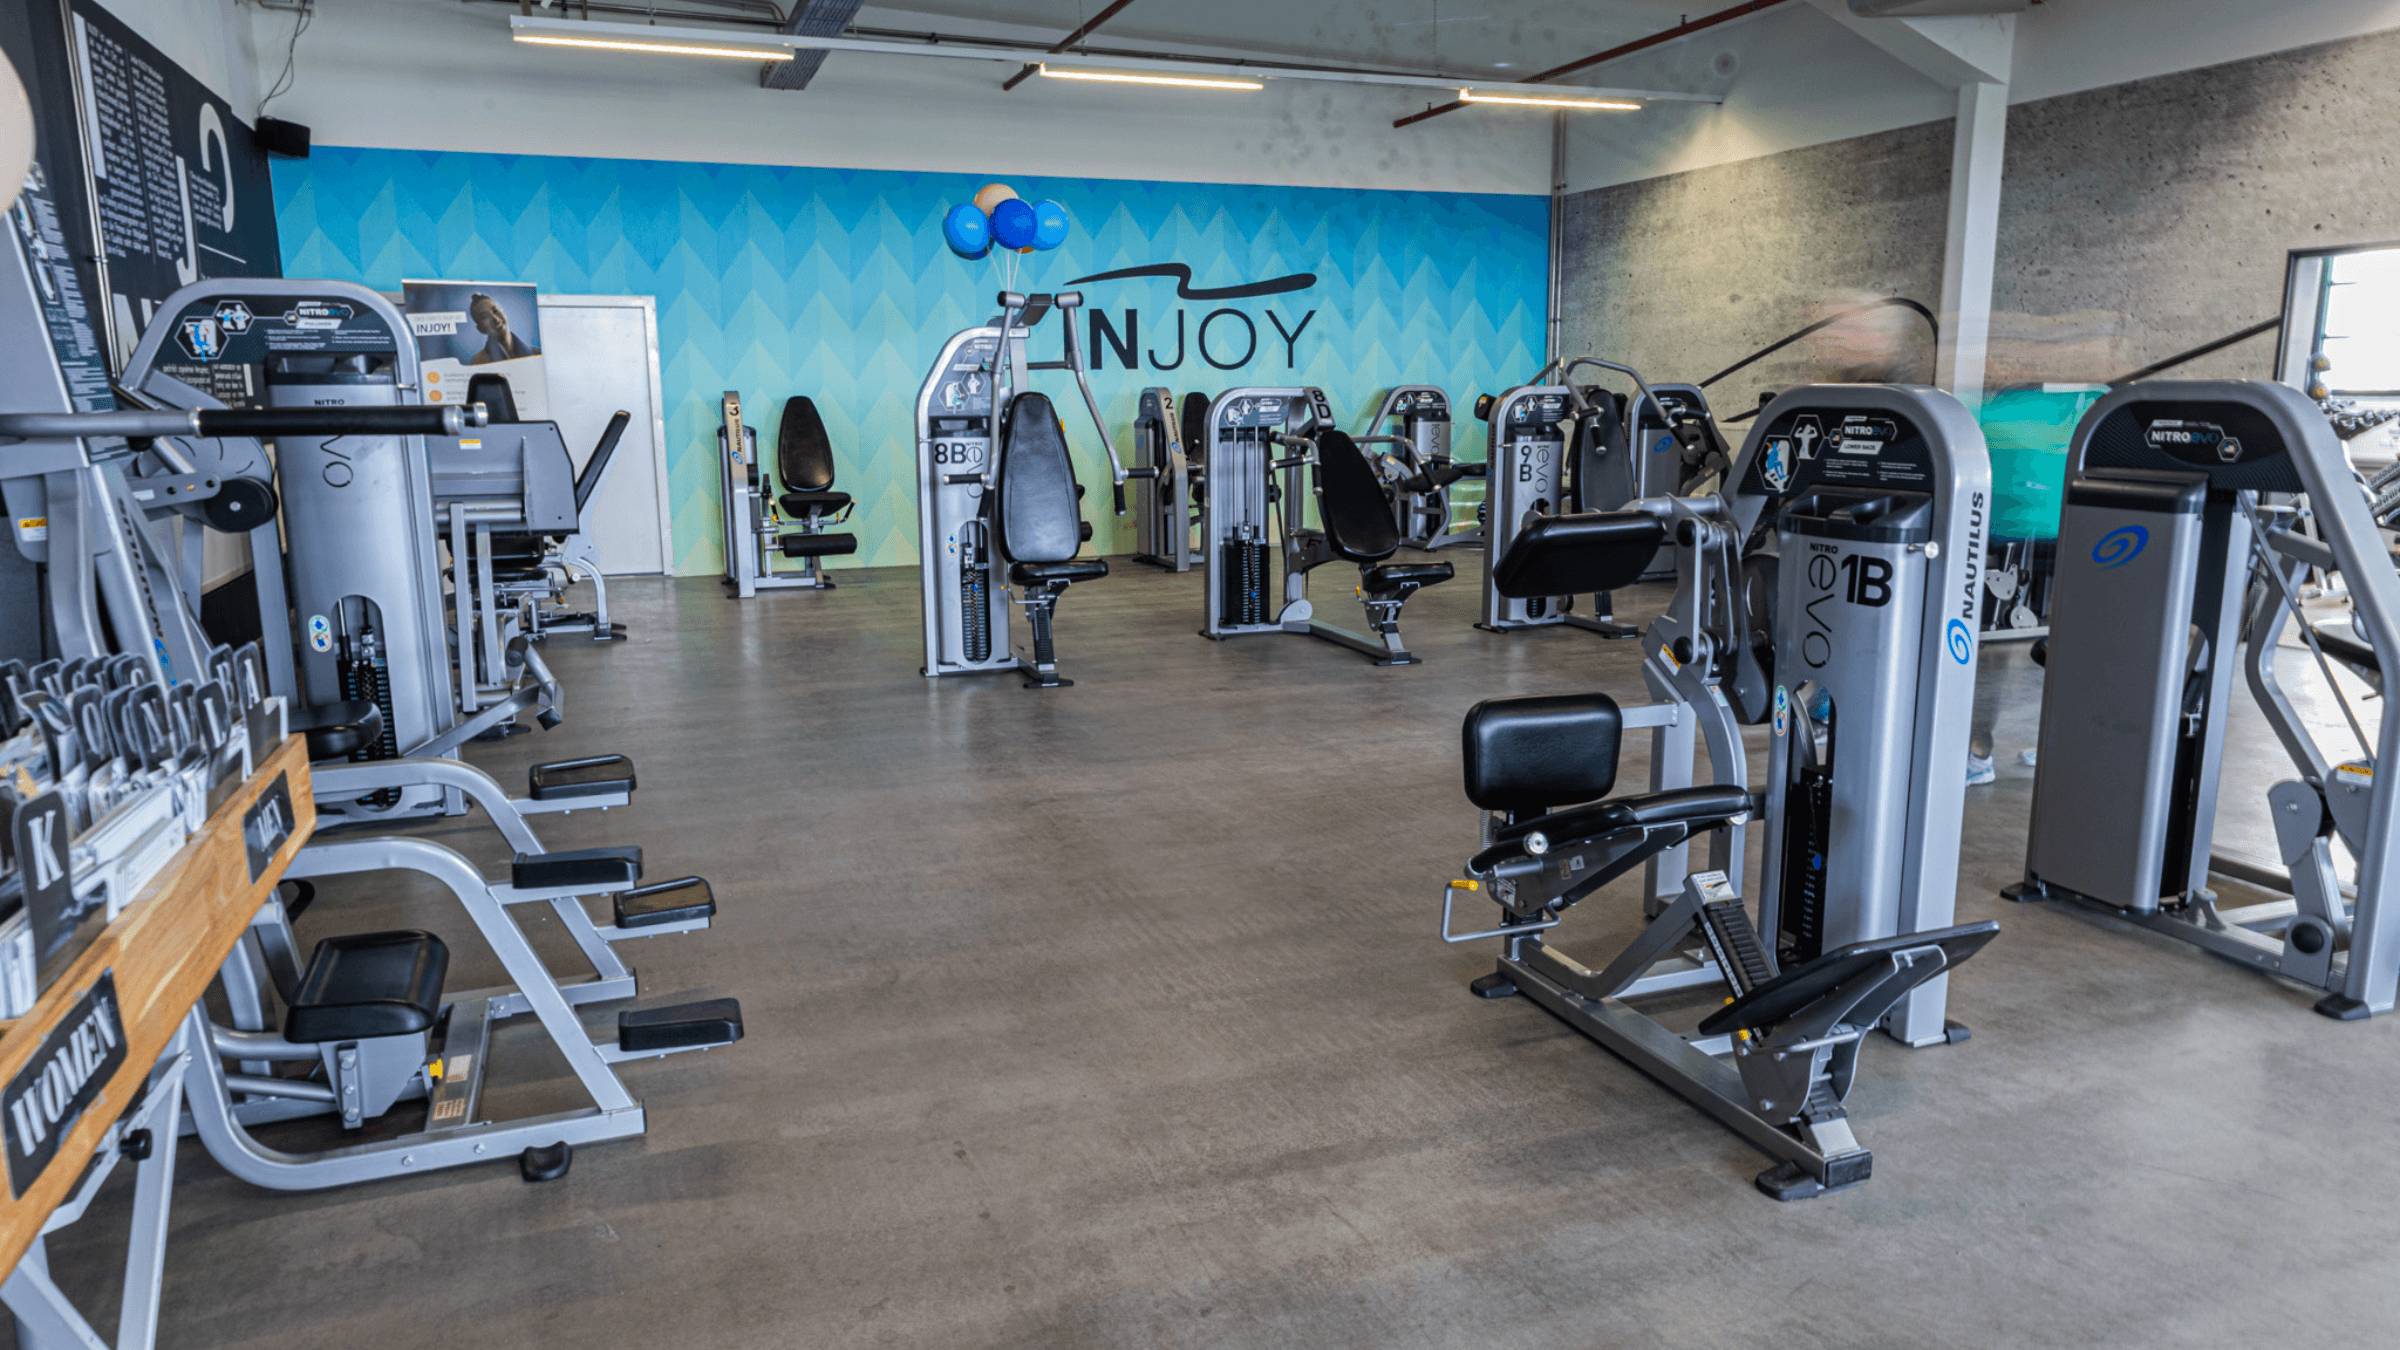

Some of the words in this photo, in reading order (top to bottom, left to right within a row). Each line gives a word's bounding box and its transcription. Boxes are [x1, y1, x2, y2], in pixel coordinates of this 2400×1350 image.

[416, 323, 451, 333] INJOY!
[1063, 308, 1316, 371] INJOY
[1164, 397, 1174, 410] 2
[935, 442, 966, 464] 8B
[1810, 543, 1838, 554] NITRO
[1961, 491, 1984, 619] NAUTILUS
[1840, 554, 1894, 608] 1B
[244, 659, 261, 710] A
[203, 697, 227, 749] L
[28, 809, 64, 891] K
[11, 997, 117, 1158] WOMEN
